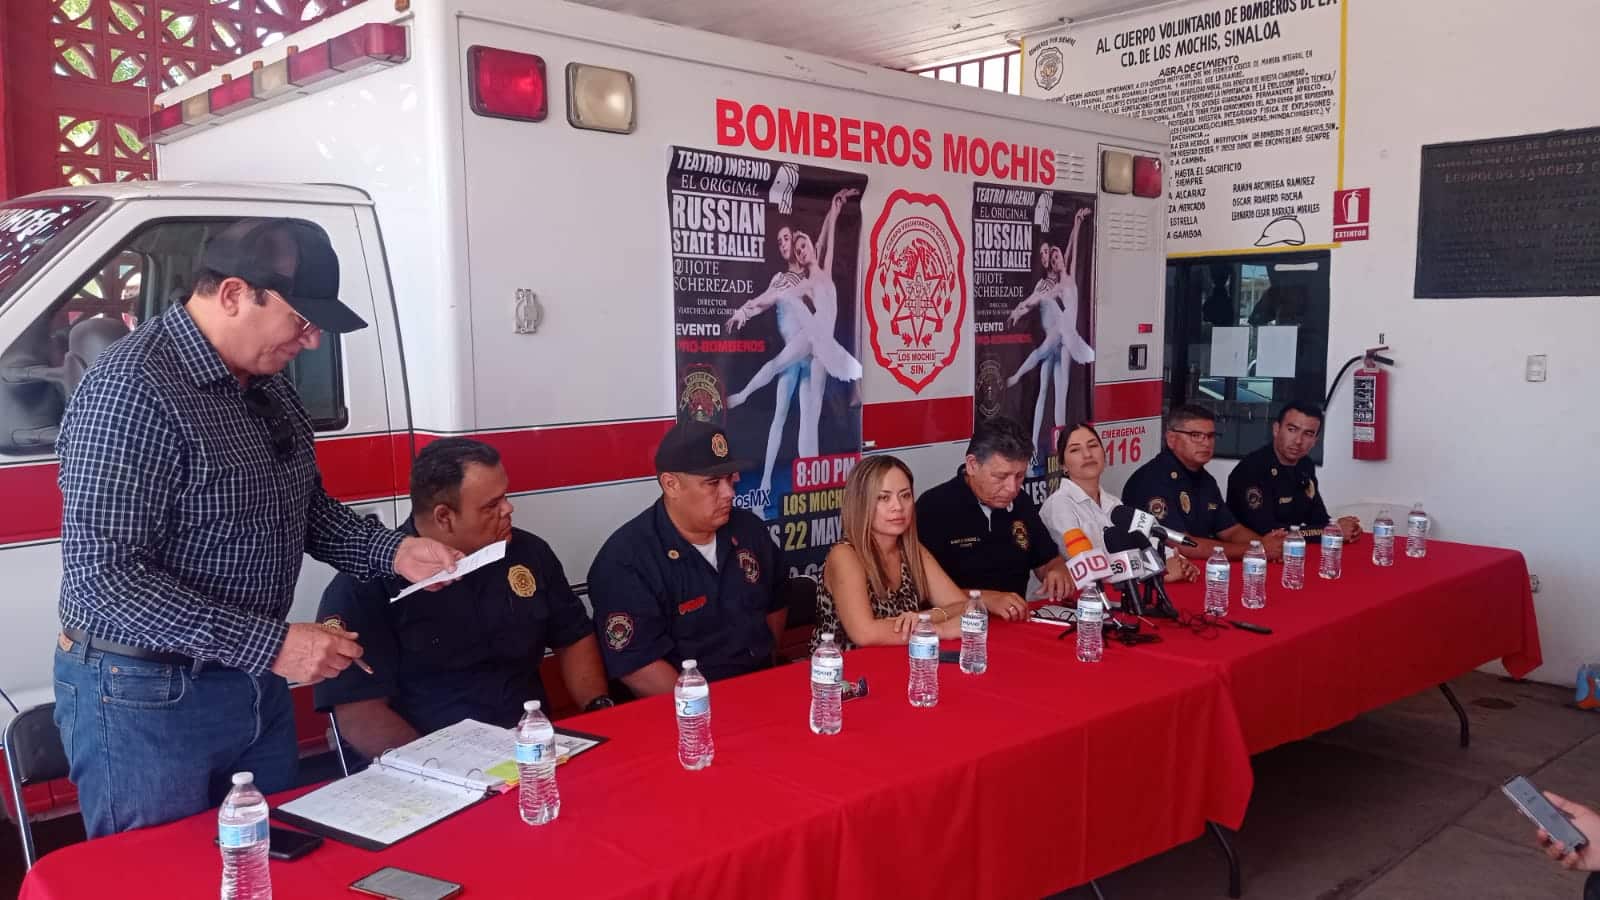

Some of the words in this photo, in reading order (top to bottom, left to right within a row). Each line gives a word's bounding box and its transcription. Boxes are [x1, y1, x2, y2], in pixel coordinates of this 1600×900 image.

[1096, 37, 1110, 55] AL
[1114, 26, 1156, 50] CUERPO
[1159, 10, 1221, 40] VOLUNTARIO
[1225, 7, 1238, 26] DE
[1240, 0, 1297, 22] BOMBEROS
[1121, 51, 1138, 67] CD.
[1140, 48, 1150, 65] DE
[1154, 44, 1171, 62] LOS
[1175, 33, 1221, 58] MOCHIS,
[1224, 20, 1280, 48] SINALOA
[1159, 55, 1240, 77] AGRADECIMIENTO
[1256, 87, 1292, 99] PERMANENTE
[716, 98, 933, 170] BOMBEROS
[943, 133, 1057, 185] MOCHIS
[1305, 132, 1329, 141] SIEMPRE
[677, 150, 723, 175] TEATRO
[724, 155, 771, 181] INGENIO
[1175, 168, 1194, 179] HASTA
[1196, 167, 1204, 176] EL
[1205, 162, 1242, 175] SACRIFICIO
[681, 174, 697, 189] EL
[700, 176, 760, 197] ORIGINAL
[1176, 177, 1203, 187] SIEMPRE
[976, 187, 1004, 203] TEATRO
[1004, 190, 1035, 206] INGENIO
[1175, 188, 1206, 200] ALCARAZ
[1232, 197, 1251, 207] OSCAR
[672, 195, 766, 236] RUSSIAN
[980, 207, 990, 218] EL
[991, 207, 1028, 220] ORIGINAL
[1178, 201, 1206, 213] MERCADO
[1170, 216, 1198, 227] ESTRELLA
[974, 223, 1032, 250] RUSSIAN
[1173, 229, 1202, 240] GAMBOA
[673, 229, 715, 255] STATE
[718, 232, 766, 258] BALLET
[974, 249, 1002, 267] STATE
[1002, 250, 1032, 268] BALLET
[673, 277, 754, 294] SCHEREZADE
[974, 286, 1024, 298] SCHEREZADE
[697, 298, 727, 306] DIRECTOR
[675, 323, 720, 336] EVENTO
[974, 322, 1004, 332] EVENTO
[898, 352, 910, 362] LOS
[911, 352, 936, 361] MOCHIS
[1101, 426, 1146, 439] EMERGENCIA
[1106, 437, 1142, 466] 116
[796, 460, 831, 487] 8:00
[784, 494, 807, 516] LOS
[784, 520, 807, 552] 22
